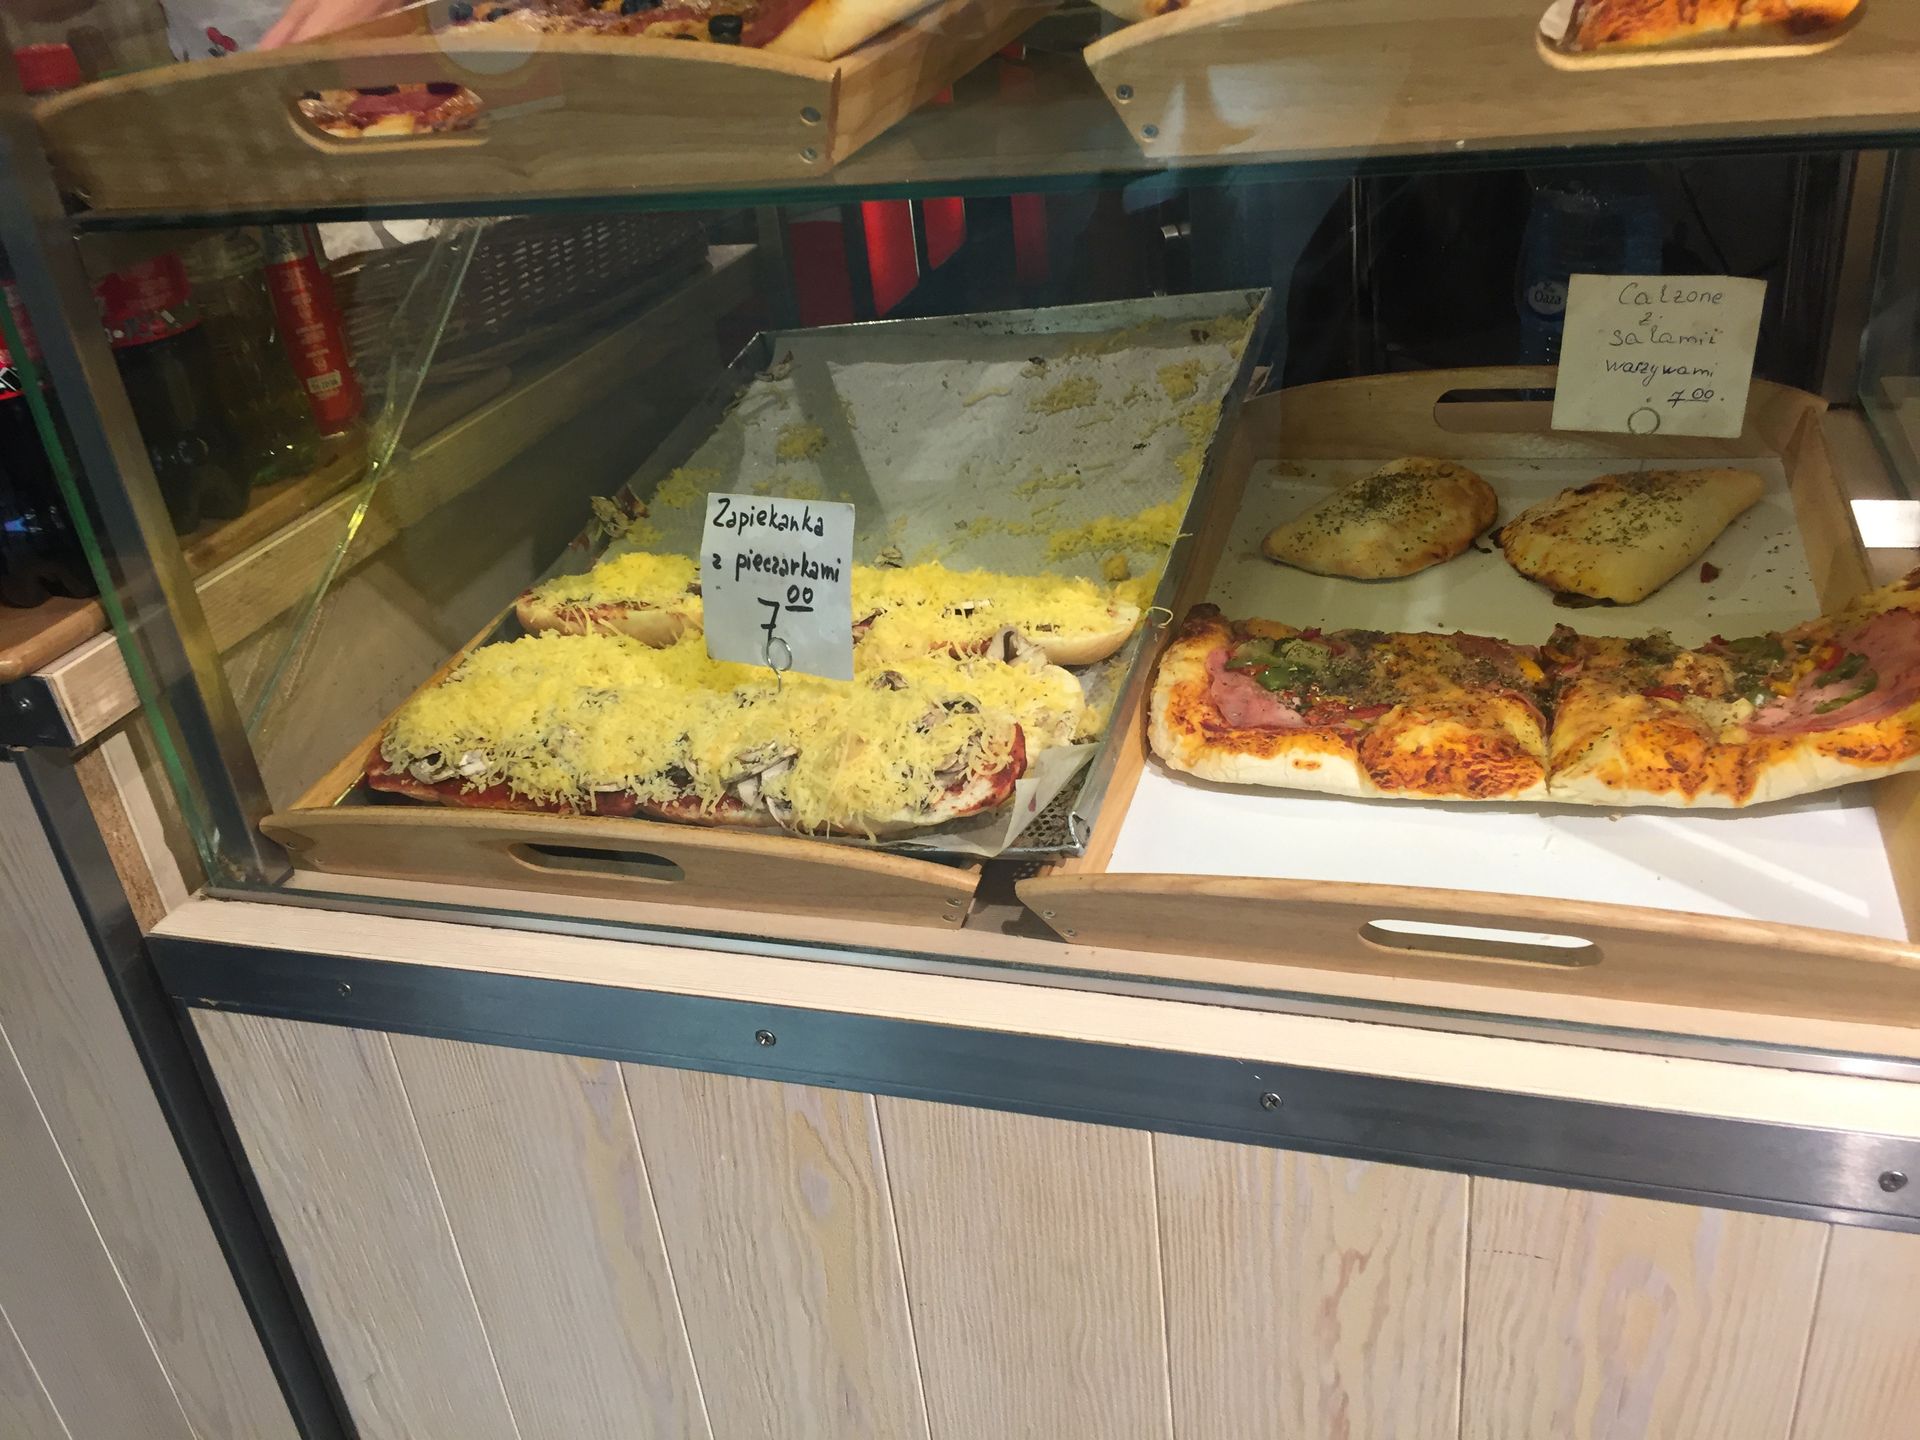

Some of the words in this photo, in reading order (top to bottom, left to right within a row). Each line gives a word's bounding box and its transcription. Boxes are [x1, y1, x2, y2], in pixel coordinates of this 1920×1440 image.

[1618, 281, 1724, 305] Calzone
[712, 497, 824, 537] Zapiekanka
[734, 548, 842, 583] pieczarkami
